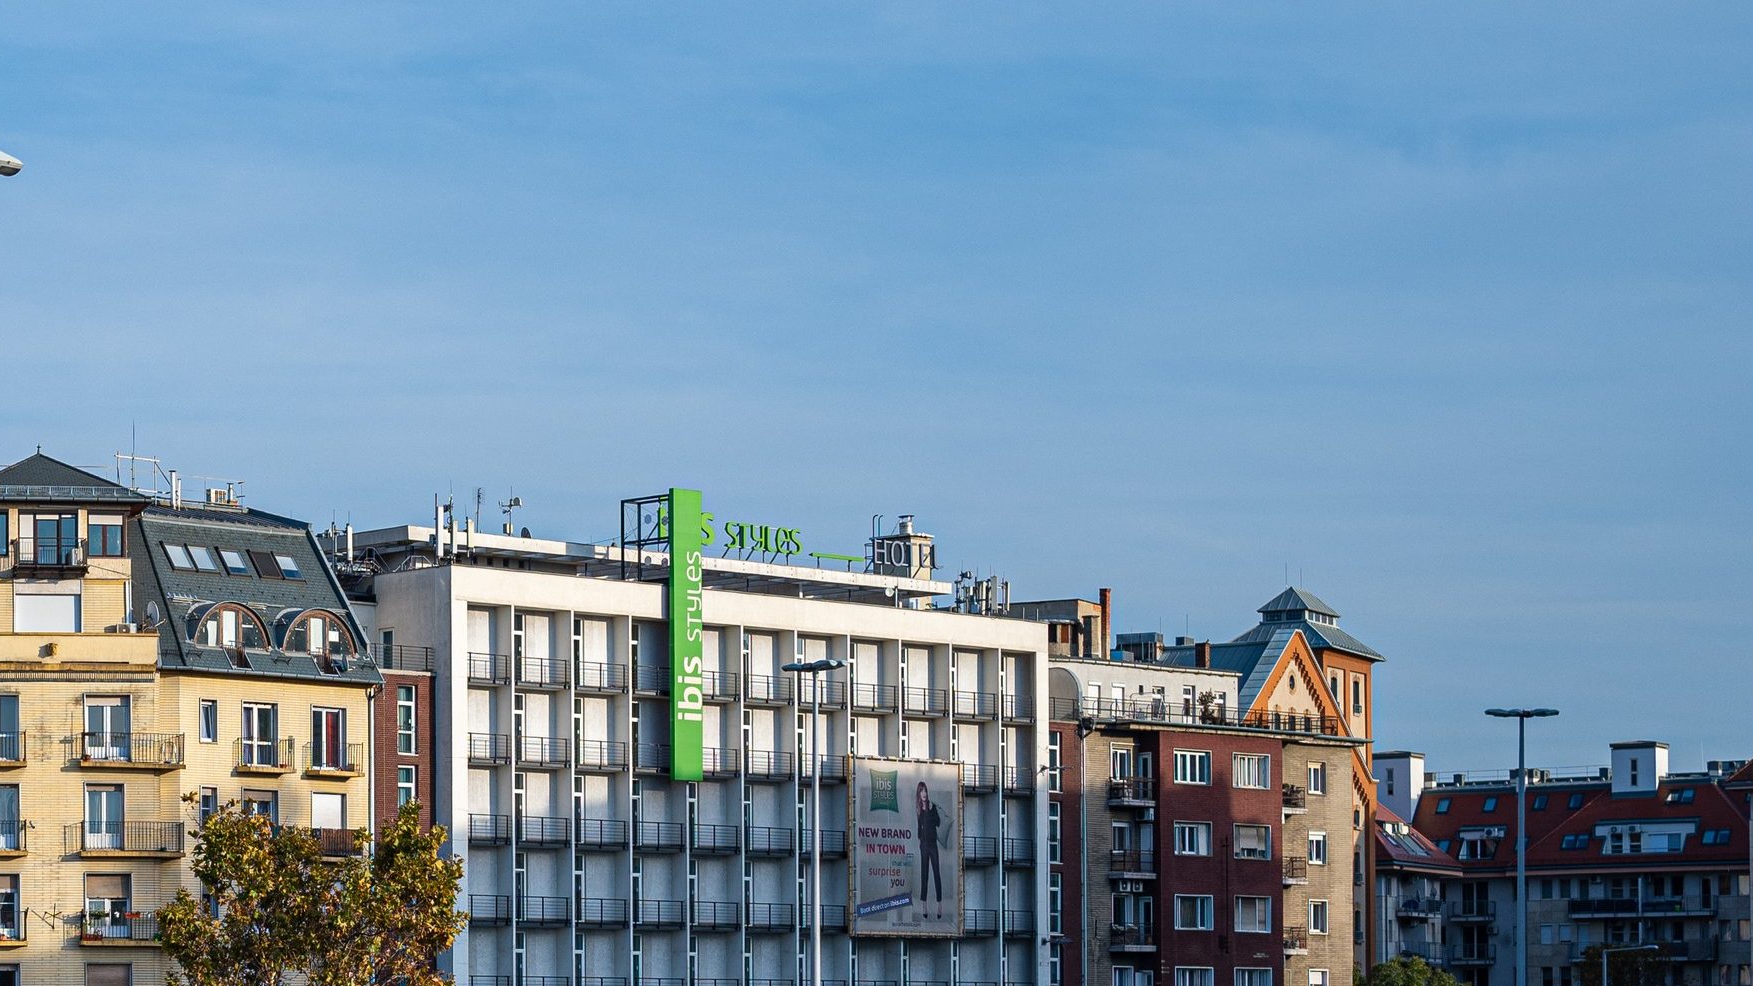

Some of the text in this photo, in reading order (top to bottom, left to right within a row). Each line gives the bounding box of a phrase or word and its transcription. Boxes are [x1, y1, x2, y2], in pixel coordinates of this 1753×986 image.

[724, 520, 803, 555] STYLES
[677, 550, 702, 722] ibis STYLES
[875, 777, 892, 790] ibis
[873, 790, 895, 800] STYLES
[858, 827, 912, 839] NEW BRAND
[866, 843, 876, 853] IN
[868, 867, 902, 878] surprise
[890, 879, 905, 888] you
